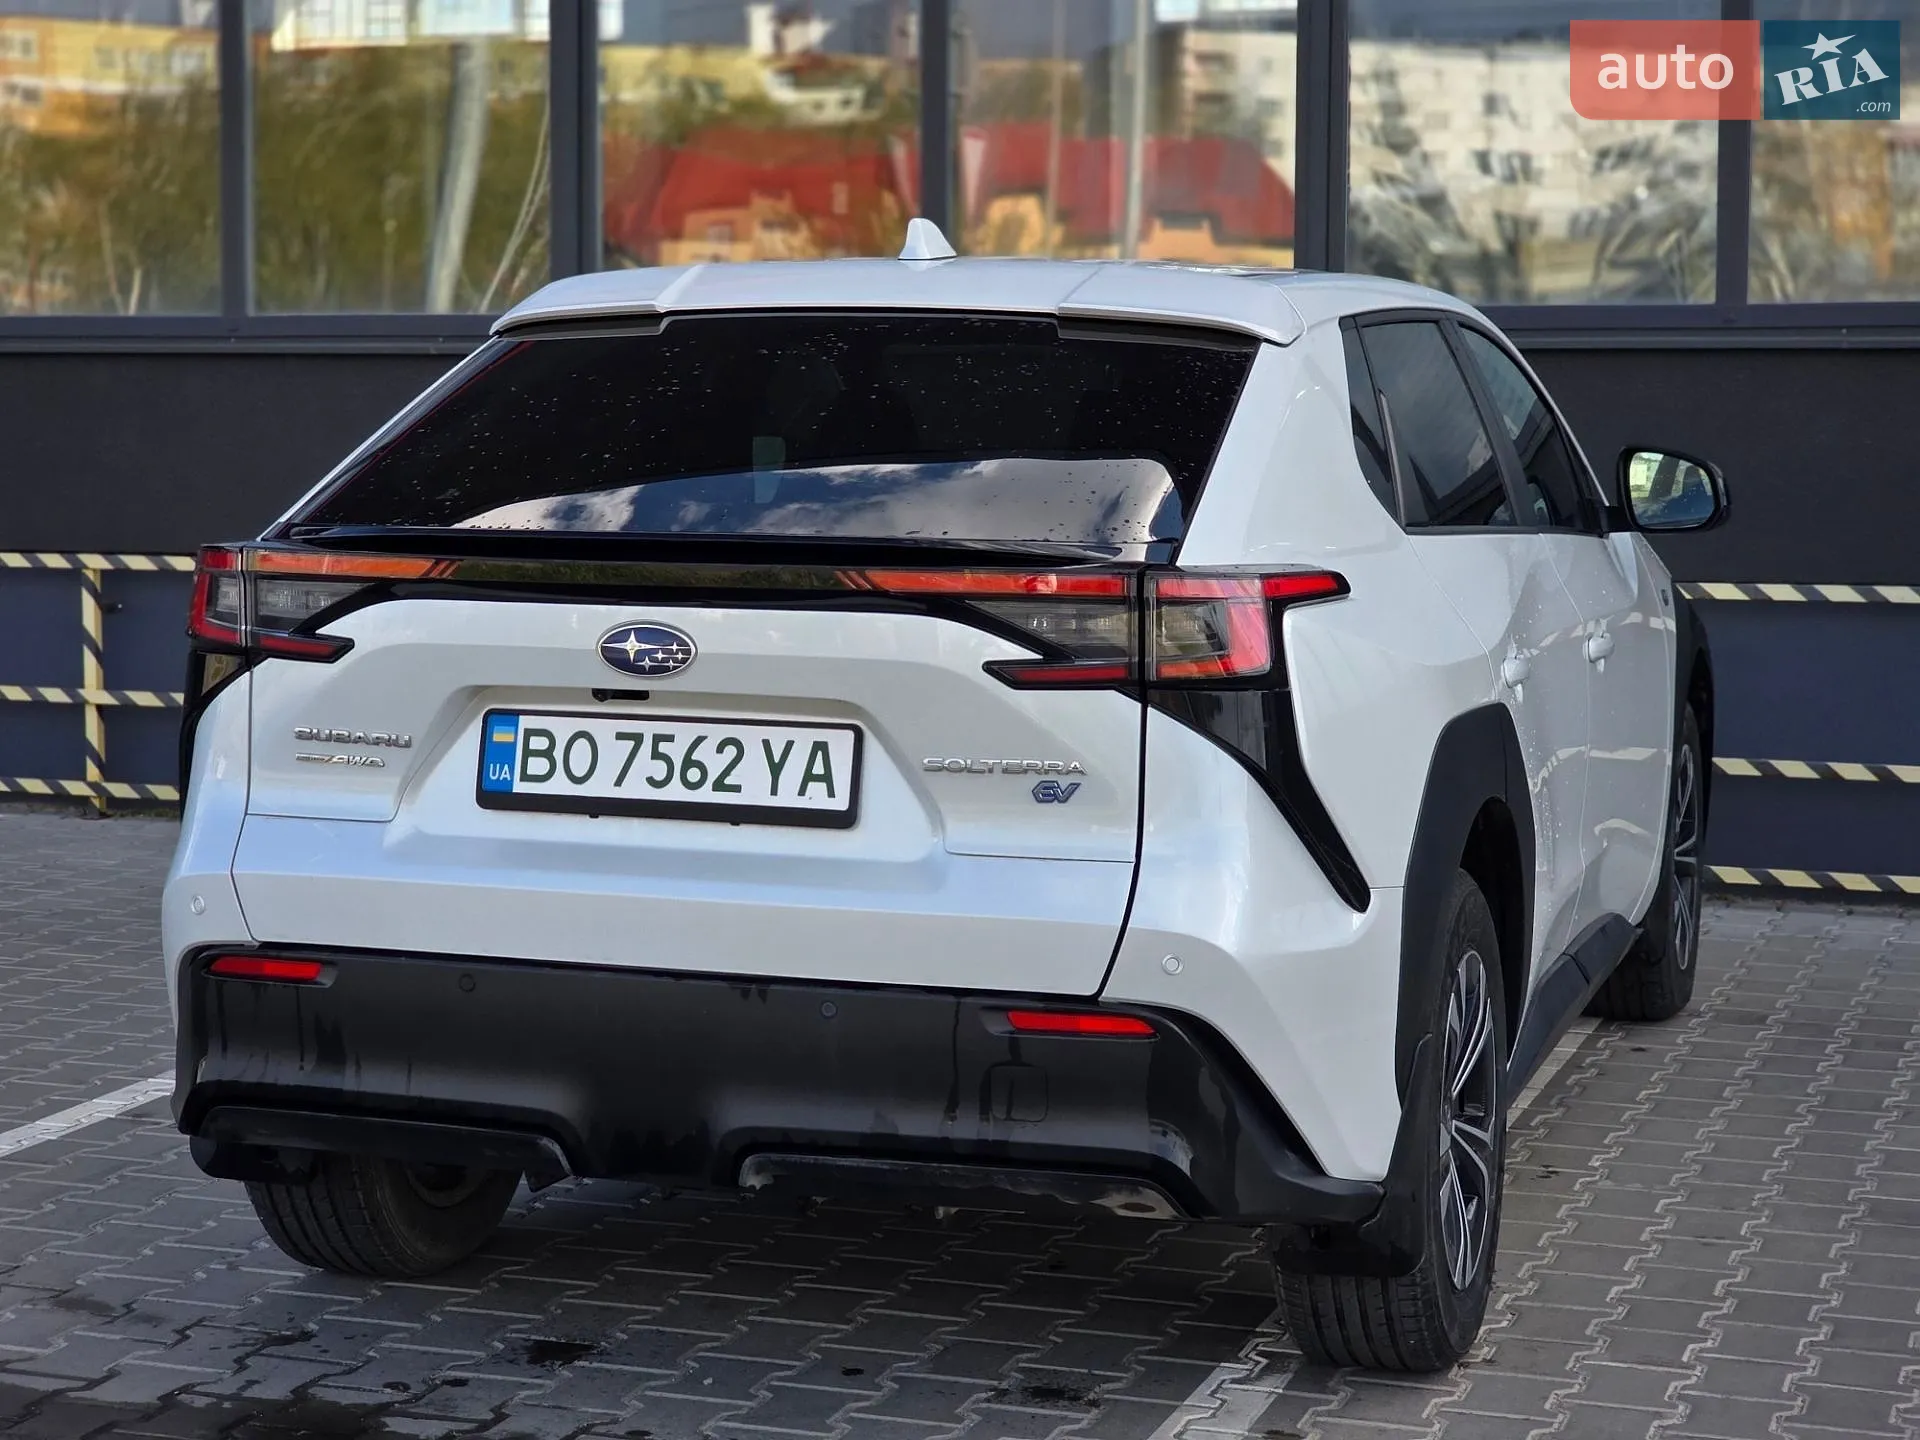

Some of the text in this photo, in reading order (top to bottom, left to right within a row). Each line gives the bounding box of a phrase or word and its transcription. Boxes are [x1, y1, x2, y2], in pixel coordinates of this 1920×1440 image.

[294, 727, 412, 748] SUBARU
[331, 754, 385, 768] AWD
[519, 727, 836, 799] BO 7562 YA
[922, 757, 1088, 776] SOLTERRA
[489, 763, 511, 781] UA
[1031, 780, 1082, 804] EV
